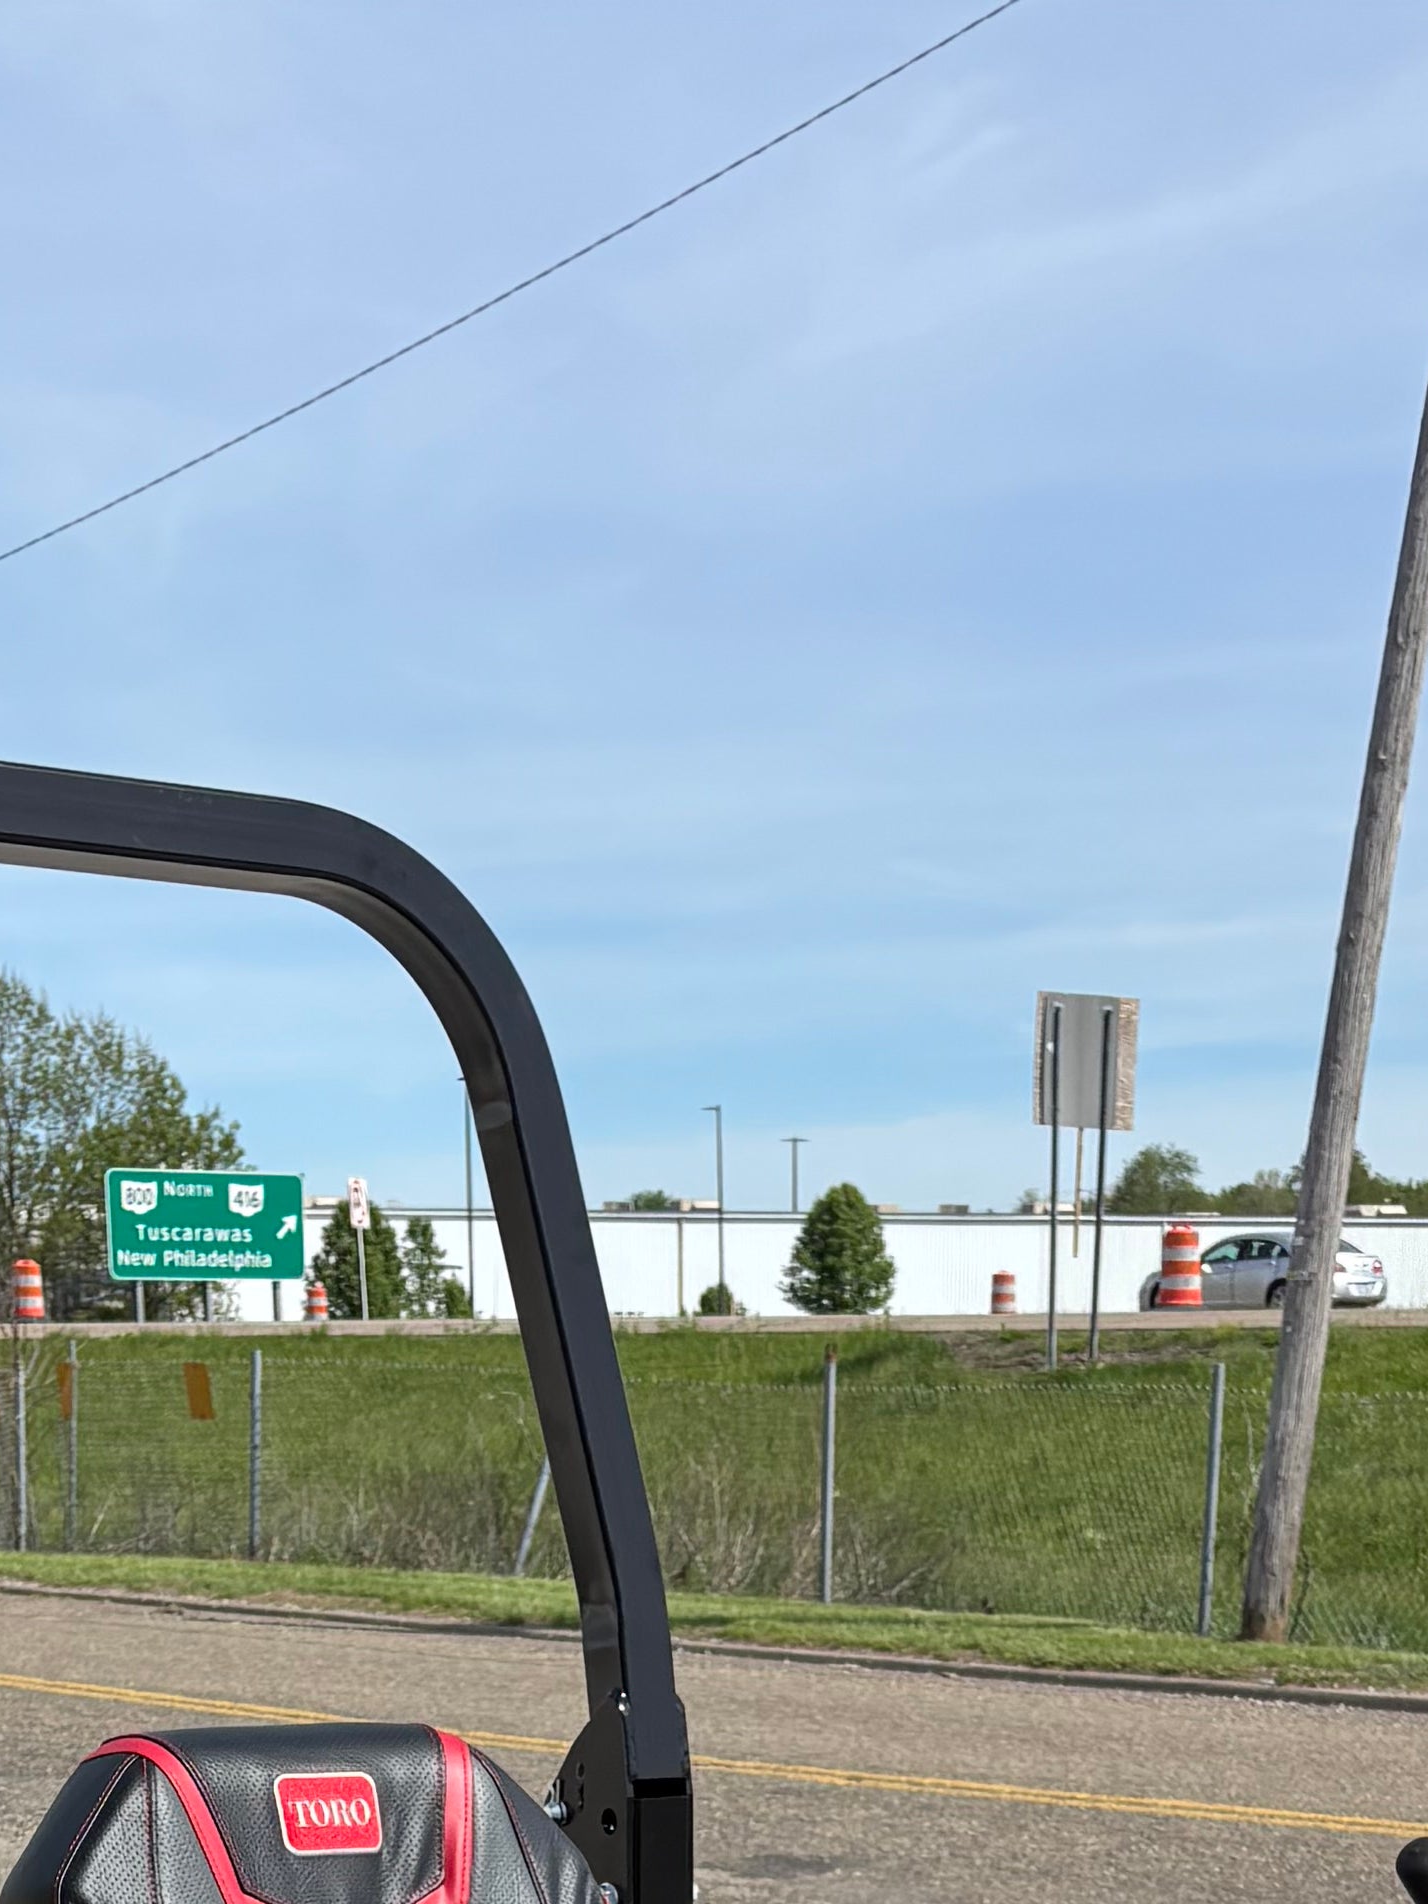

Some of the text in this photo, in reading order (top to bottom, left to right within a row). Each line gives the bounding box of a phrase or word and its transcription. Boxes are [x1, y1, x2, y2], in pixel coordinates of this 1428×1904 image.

[233, 1190, 261, 1208] 416
[135, 1224, 253, 1242] Tuscarawas
[117, 1249, 272, 1272] New Philadelphia
[287, 1797, 371, 1829] TORO
